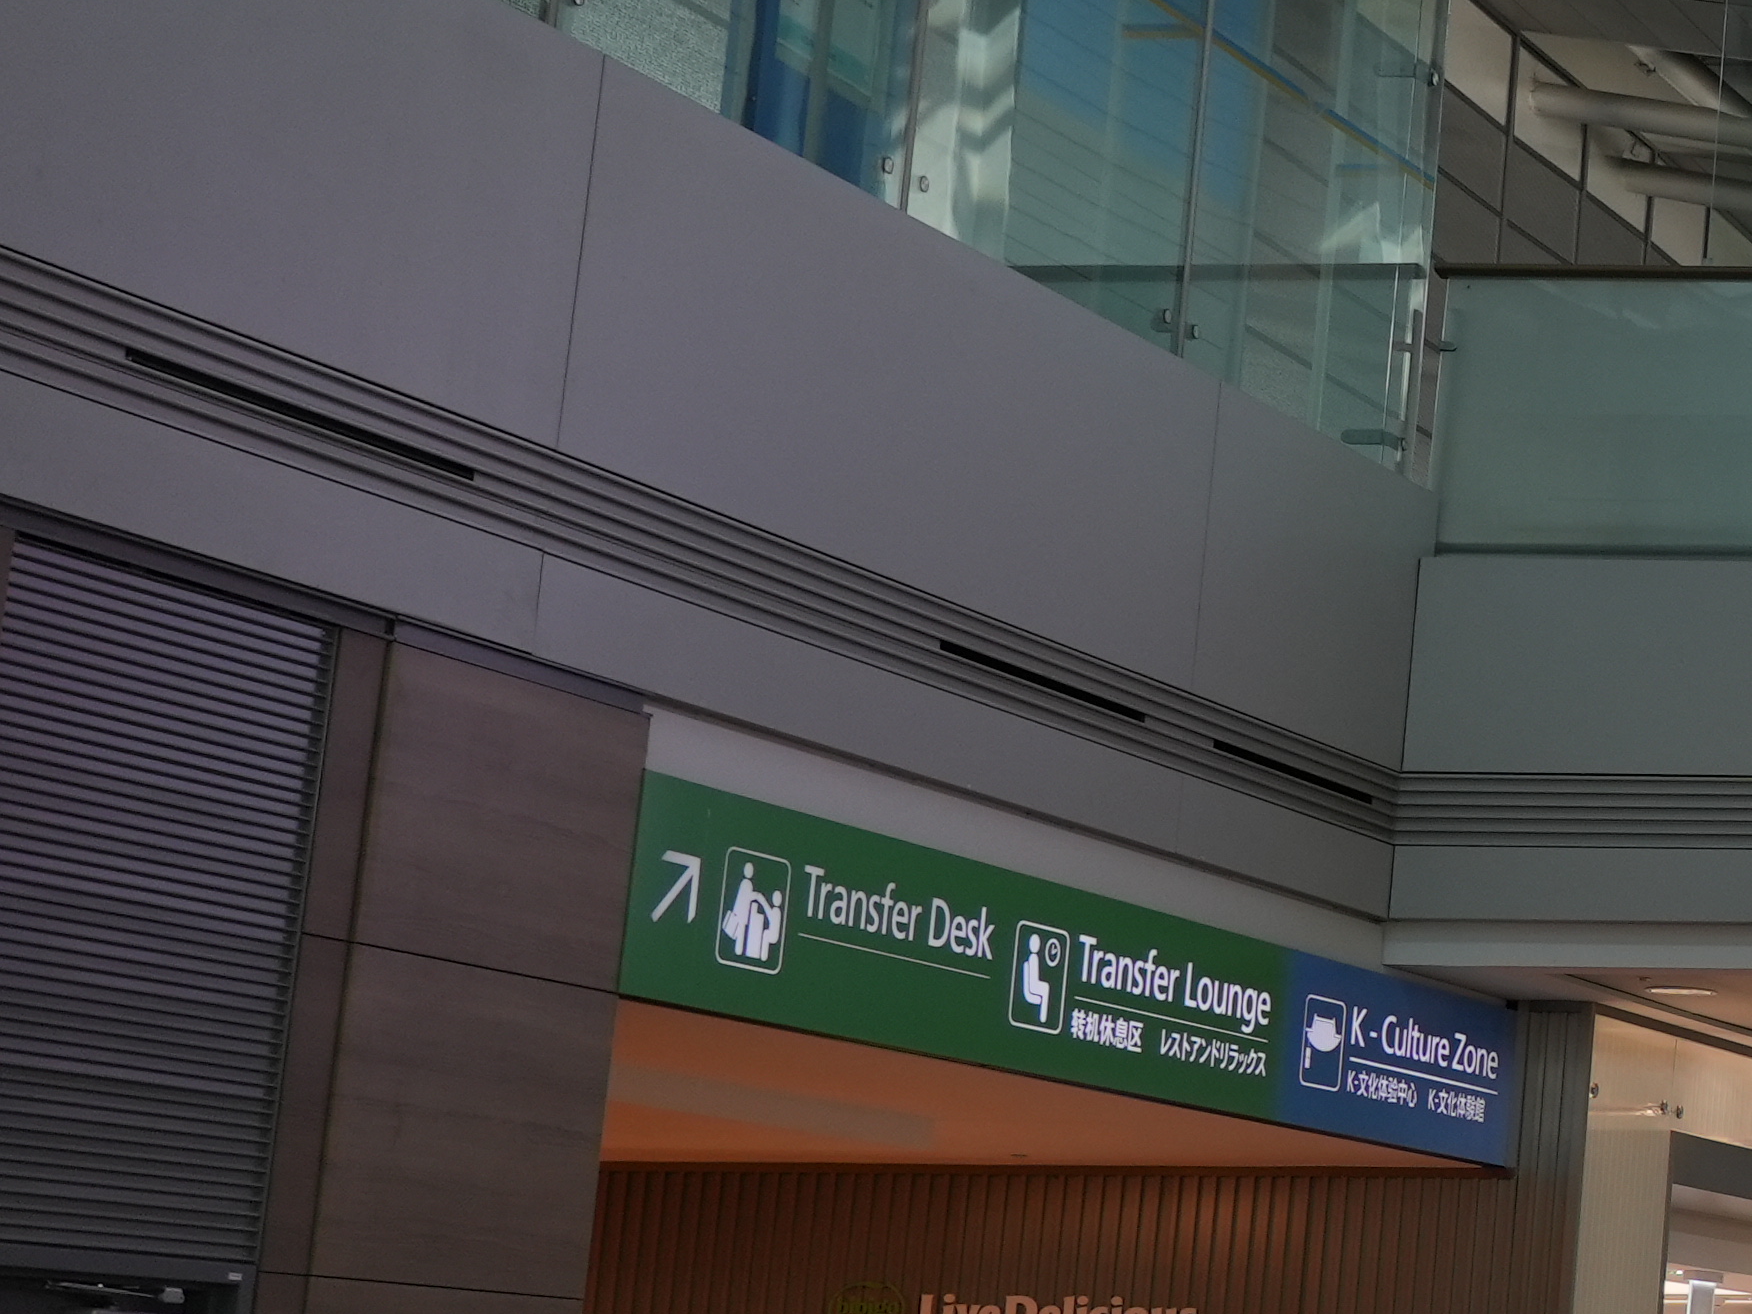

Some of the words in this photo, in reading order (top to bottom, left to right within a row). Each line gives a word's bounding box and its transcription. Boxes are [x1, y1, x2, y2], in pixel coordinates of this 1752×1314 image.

[804, 864, 922, 943] Transfer
[927, 903, 994, 963] Desk
[1078, 935, 1180, 1002] Transfer
[1185, 972, 1272, 1035] Lounge
[1071, 1006, 1144, 1054] 转机休息区
[1159, 1027, 1268, 1079] レストアンドリラックス
[1350, 1005, 1367, 1048] K
[1381, 1014, 1450, 1068] Culture
[1451, 1032, 1499, 1080] Zone
